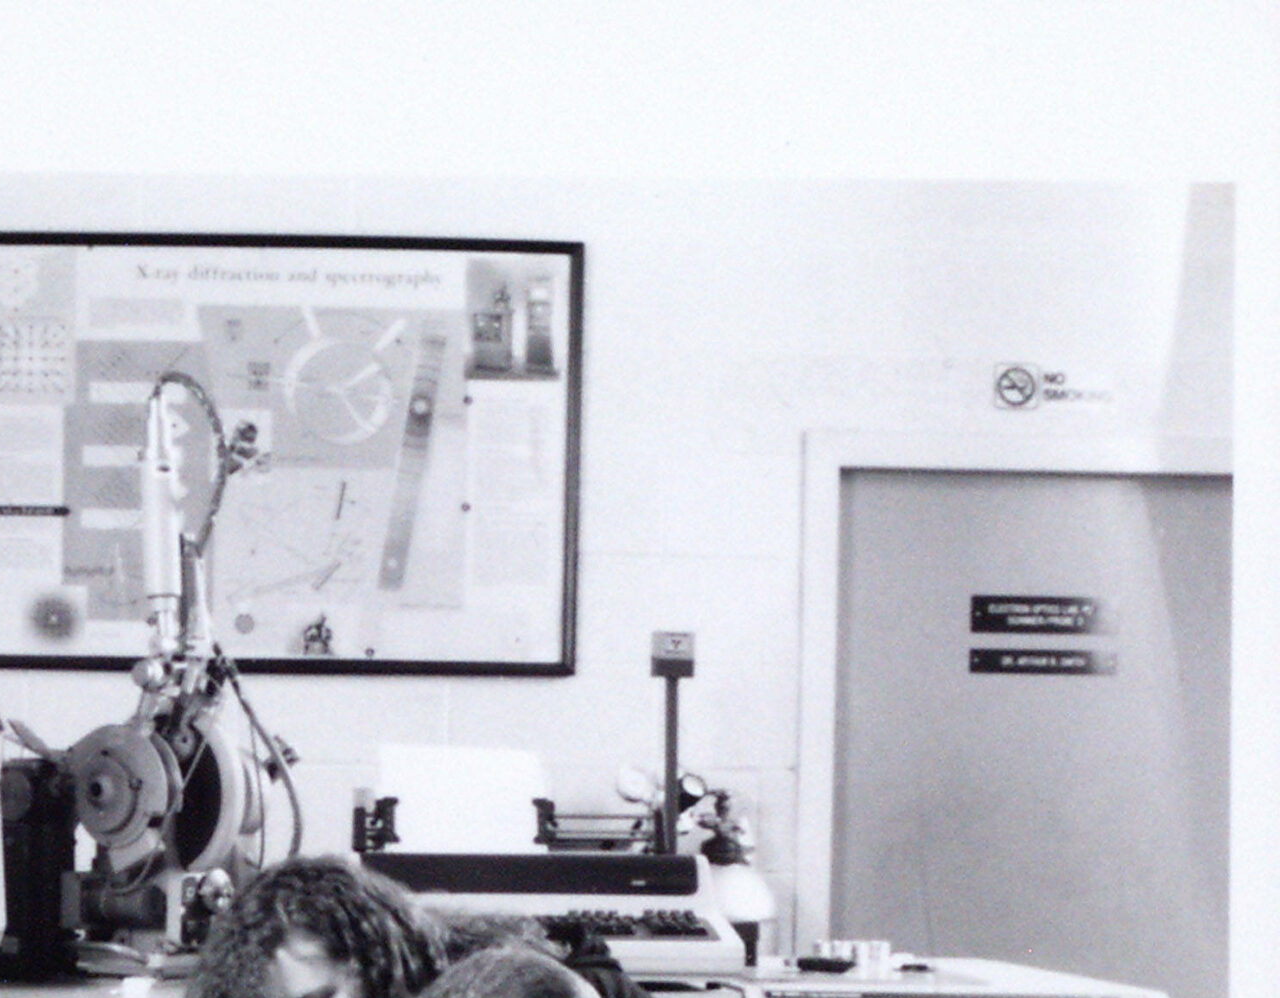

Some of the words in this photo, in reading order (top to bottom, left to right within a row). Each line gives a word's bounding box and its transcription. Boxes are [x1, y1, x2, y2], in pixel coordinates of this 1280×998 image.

[187, 264, 281, 282] diffraction
[287, 267, 318, 283] and
[1043, 373, 1065, 385] NO
